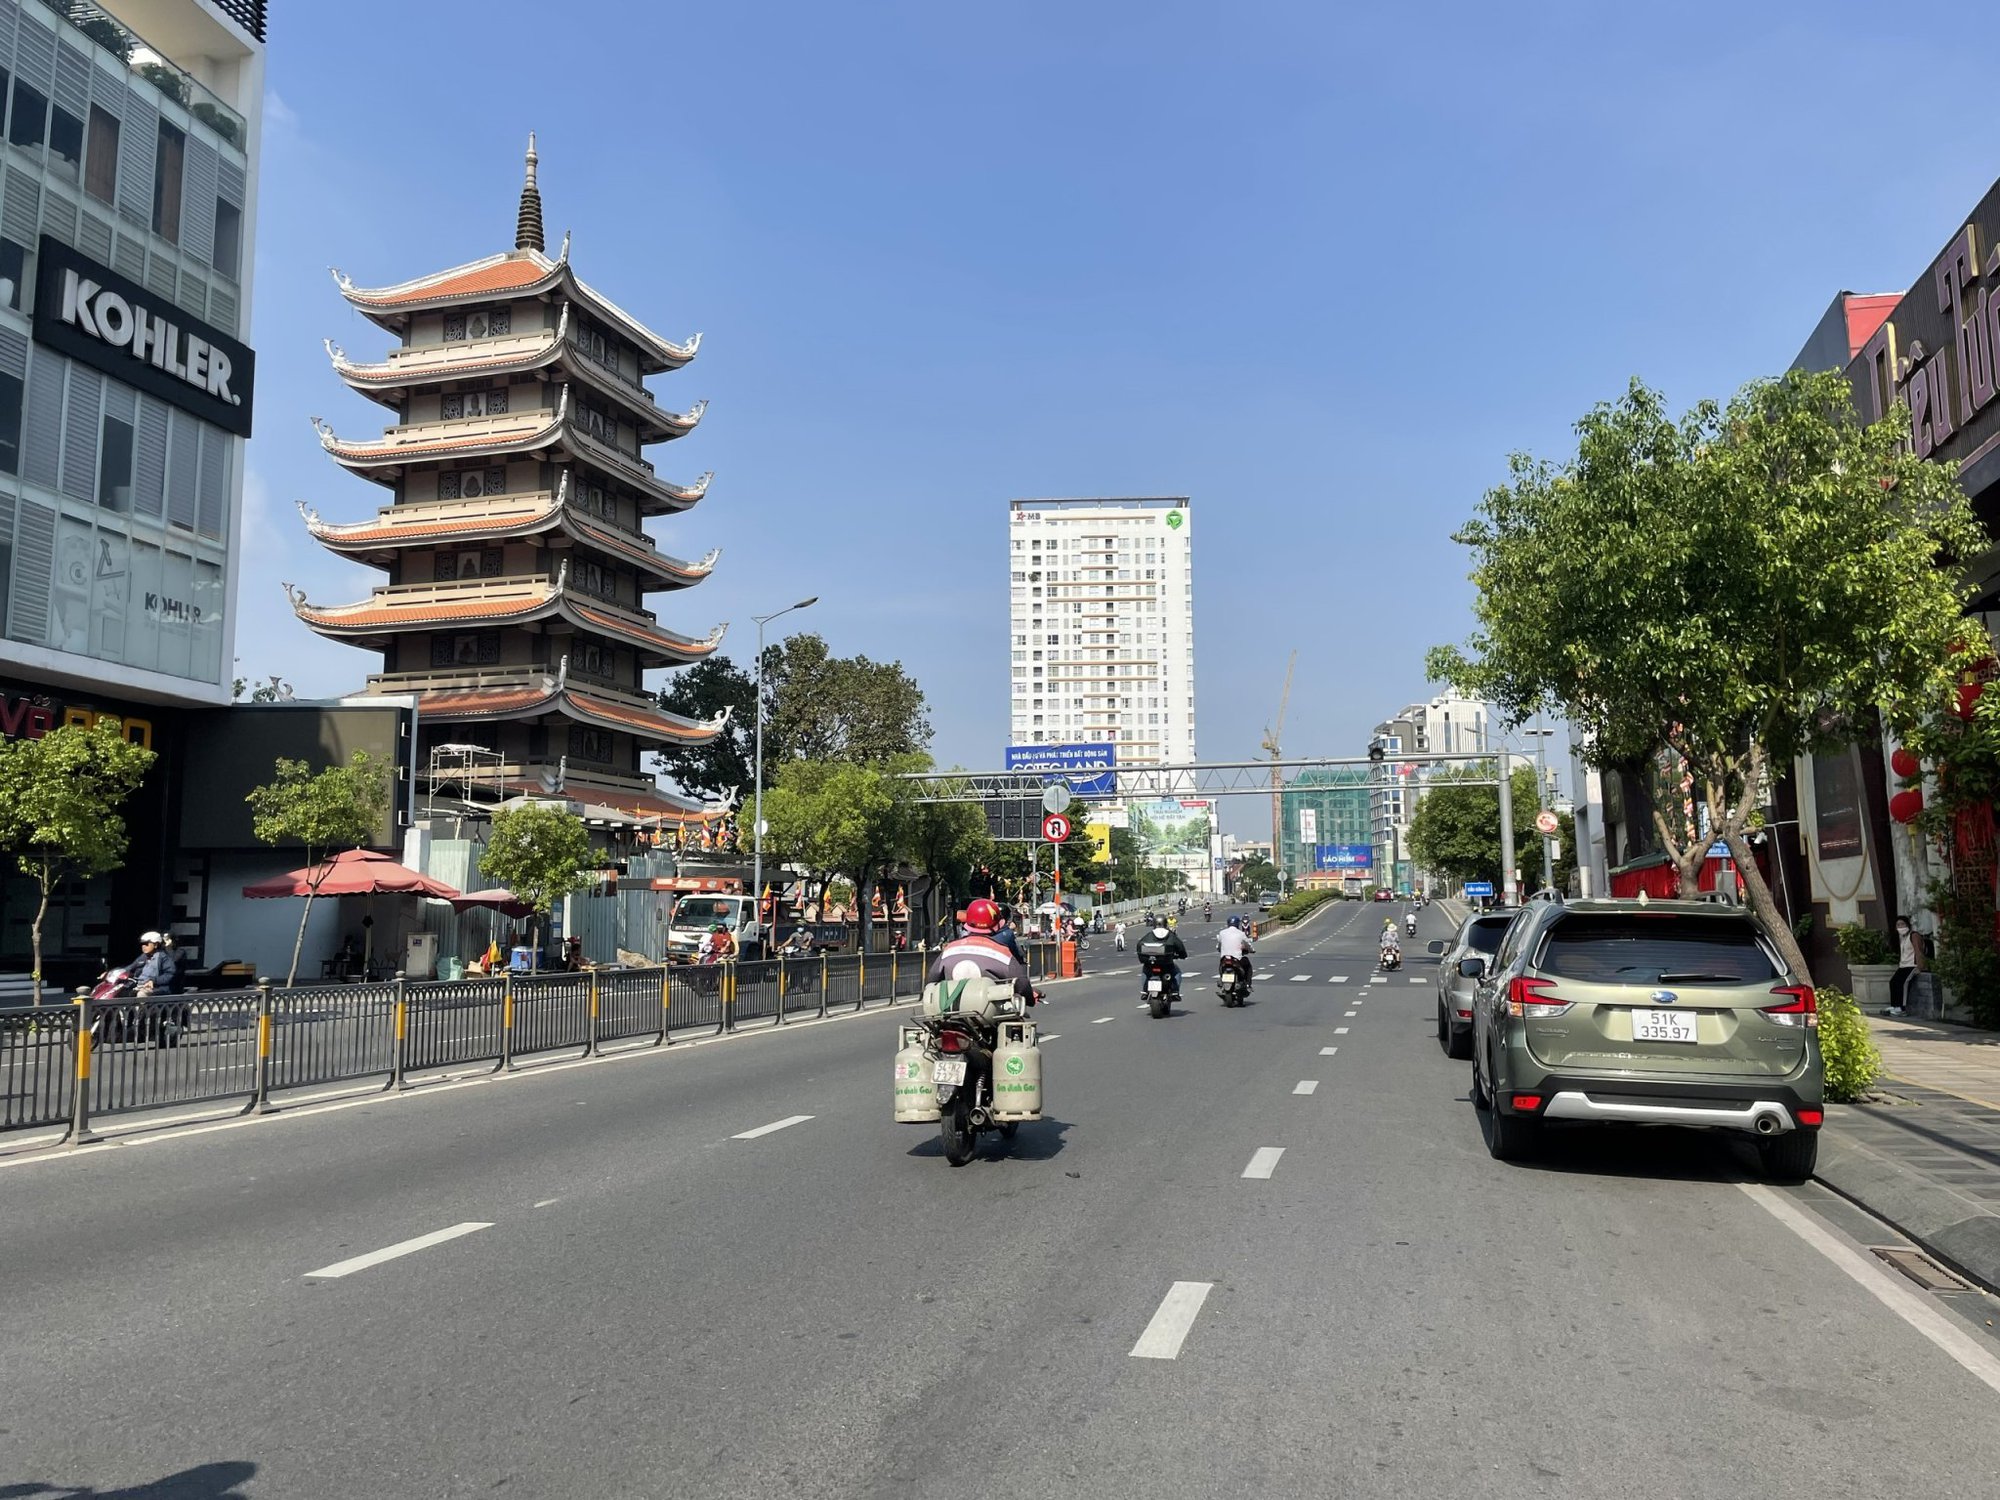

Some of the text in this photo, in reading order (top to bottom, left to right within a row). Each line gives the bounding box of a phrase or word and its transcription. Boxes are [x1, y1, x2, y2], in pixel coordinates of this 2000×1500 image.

[1027, 512, 1041, 520] MB
[1651, 1013, 1678, 1025] 51K
[1641, 1026, 1690, 1039] 335.97
